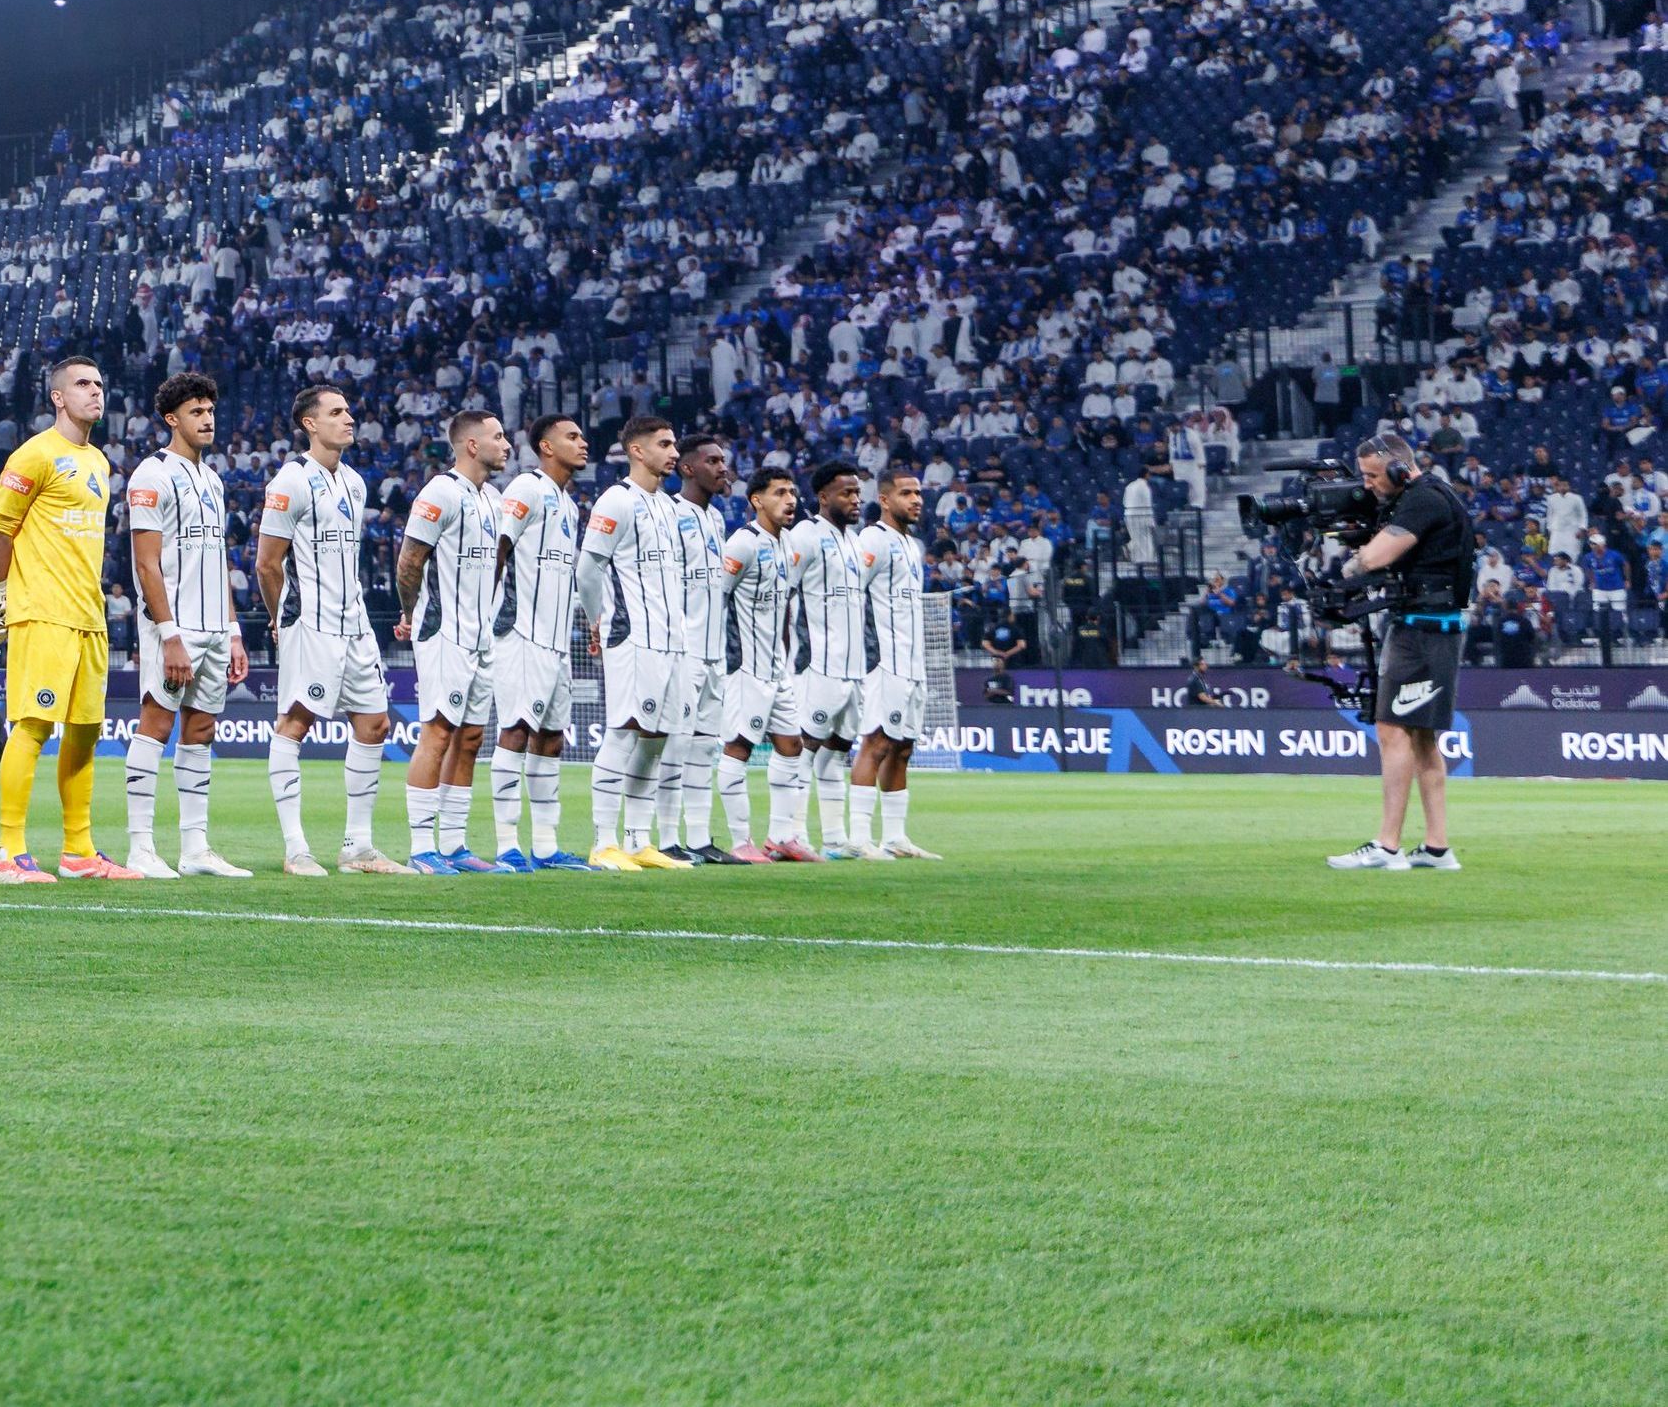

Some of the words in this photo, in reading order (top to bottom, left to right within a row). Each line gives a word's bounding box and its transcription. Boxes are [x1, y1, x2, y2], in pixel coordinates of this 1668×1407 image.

[175, 525, 226, 541] JETO
[1399, 679, 1434, 705] NIKE
[917, 727, 996, 755] SAUDI
[1012, 727, 1113, 755] LEAGUE
[1165, 729, 1266, 757] ROSHN
[1278, 729, 1368, 758] SAUDI
